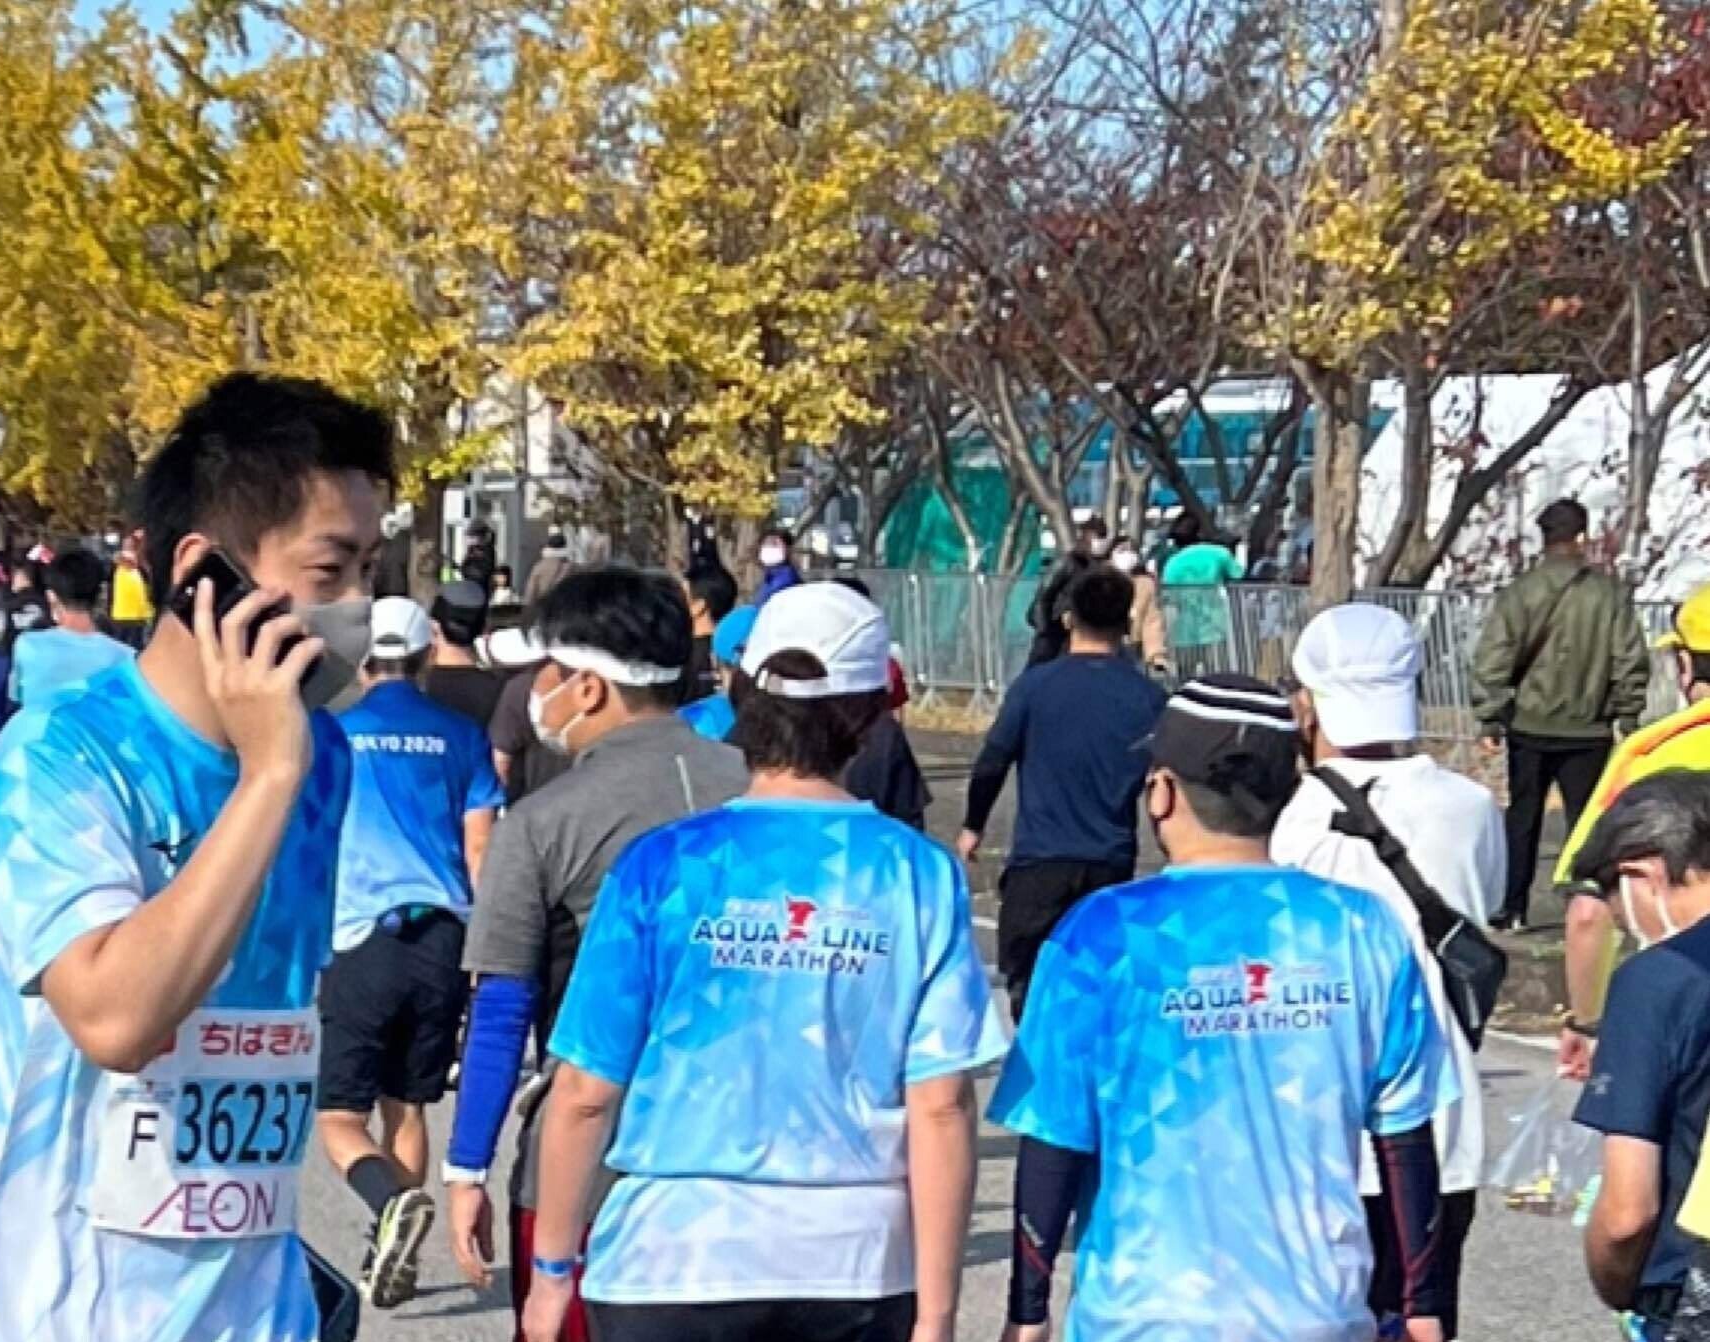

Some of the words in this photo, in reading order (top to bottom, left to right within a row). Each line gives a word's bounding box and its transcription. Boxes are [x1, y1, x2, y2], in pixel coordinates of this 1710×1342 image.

[694, 919, 780, 942] AQUA
[822, 926, 891, 954] LINE
[714, 947, 868, 975] MARATHON
[1163, 987, 1245, 1014] AQUA
[1283, 983, 1352, 1005] LINE
[1187, 1009, 1332, 1035] MARATHON
[127, 1112, 160, 1161] F
[176, 1082, 313, 1164] 36237
